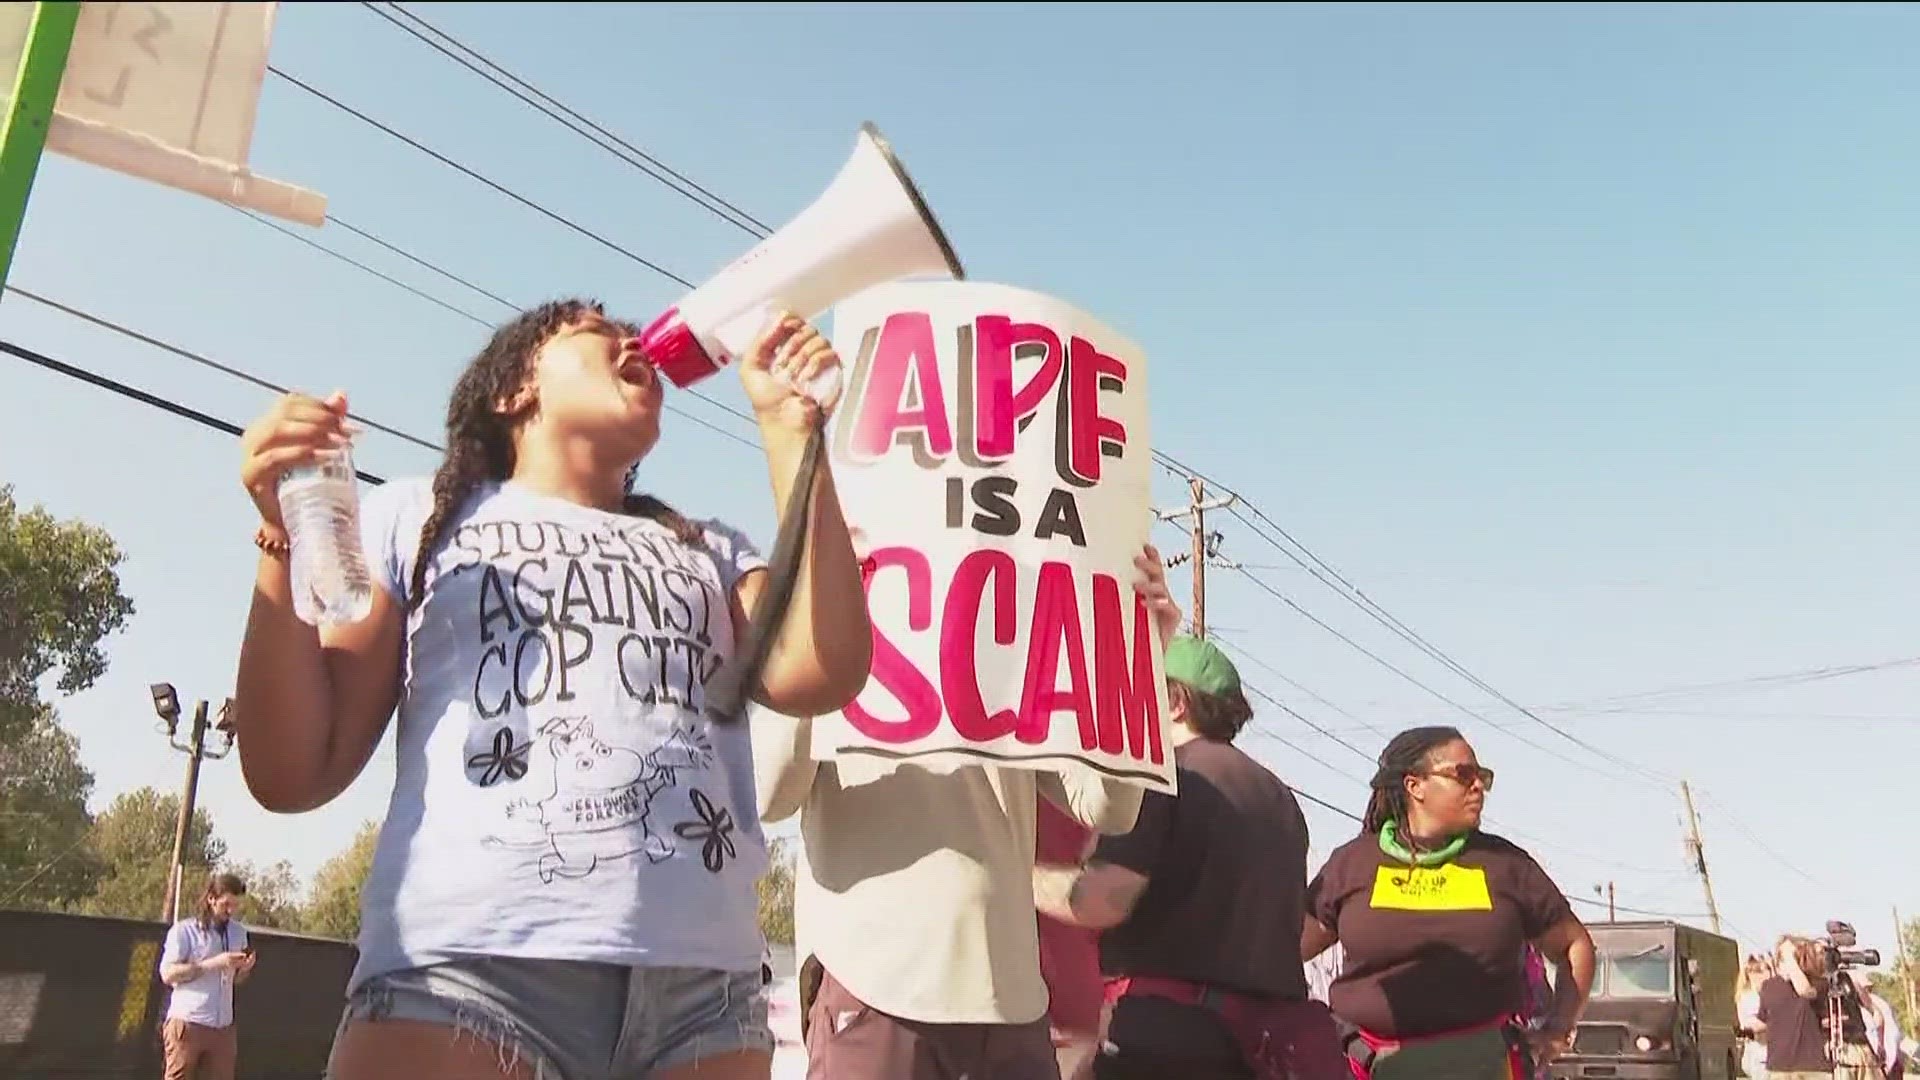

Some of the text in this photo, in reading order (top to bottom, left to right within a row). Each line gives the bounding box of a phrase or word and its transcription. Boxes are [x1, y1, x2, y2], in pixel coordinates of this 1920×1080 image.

[834, 311, 1127, 486] APF
[946, 476, 1087, 547] IS A
[479, 558, 712, 645] AGAINST
[474, 621, 594, 719] COP
[842, 546, 1165, 766] SCAM
